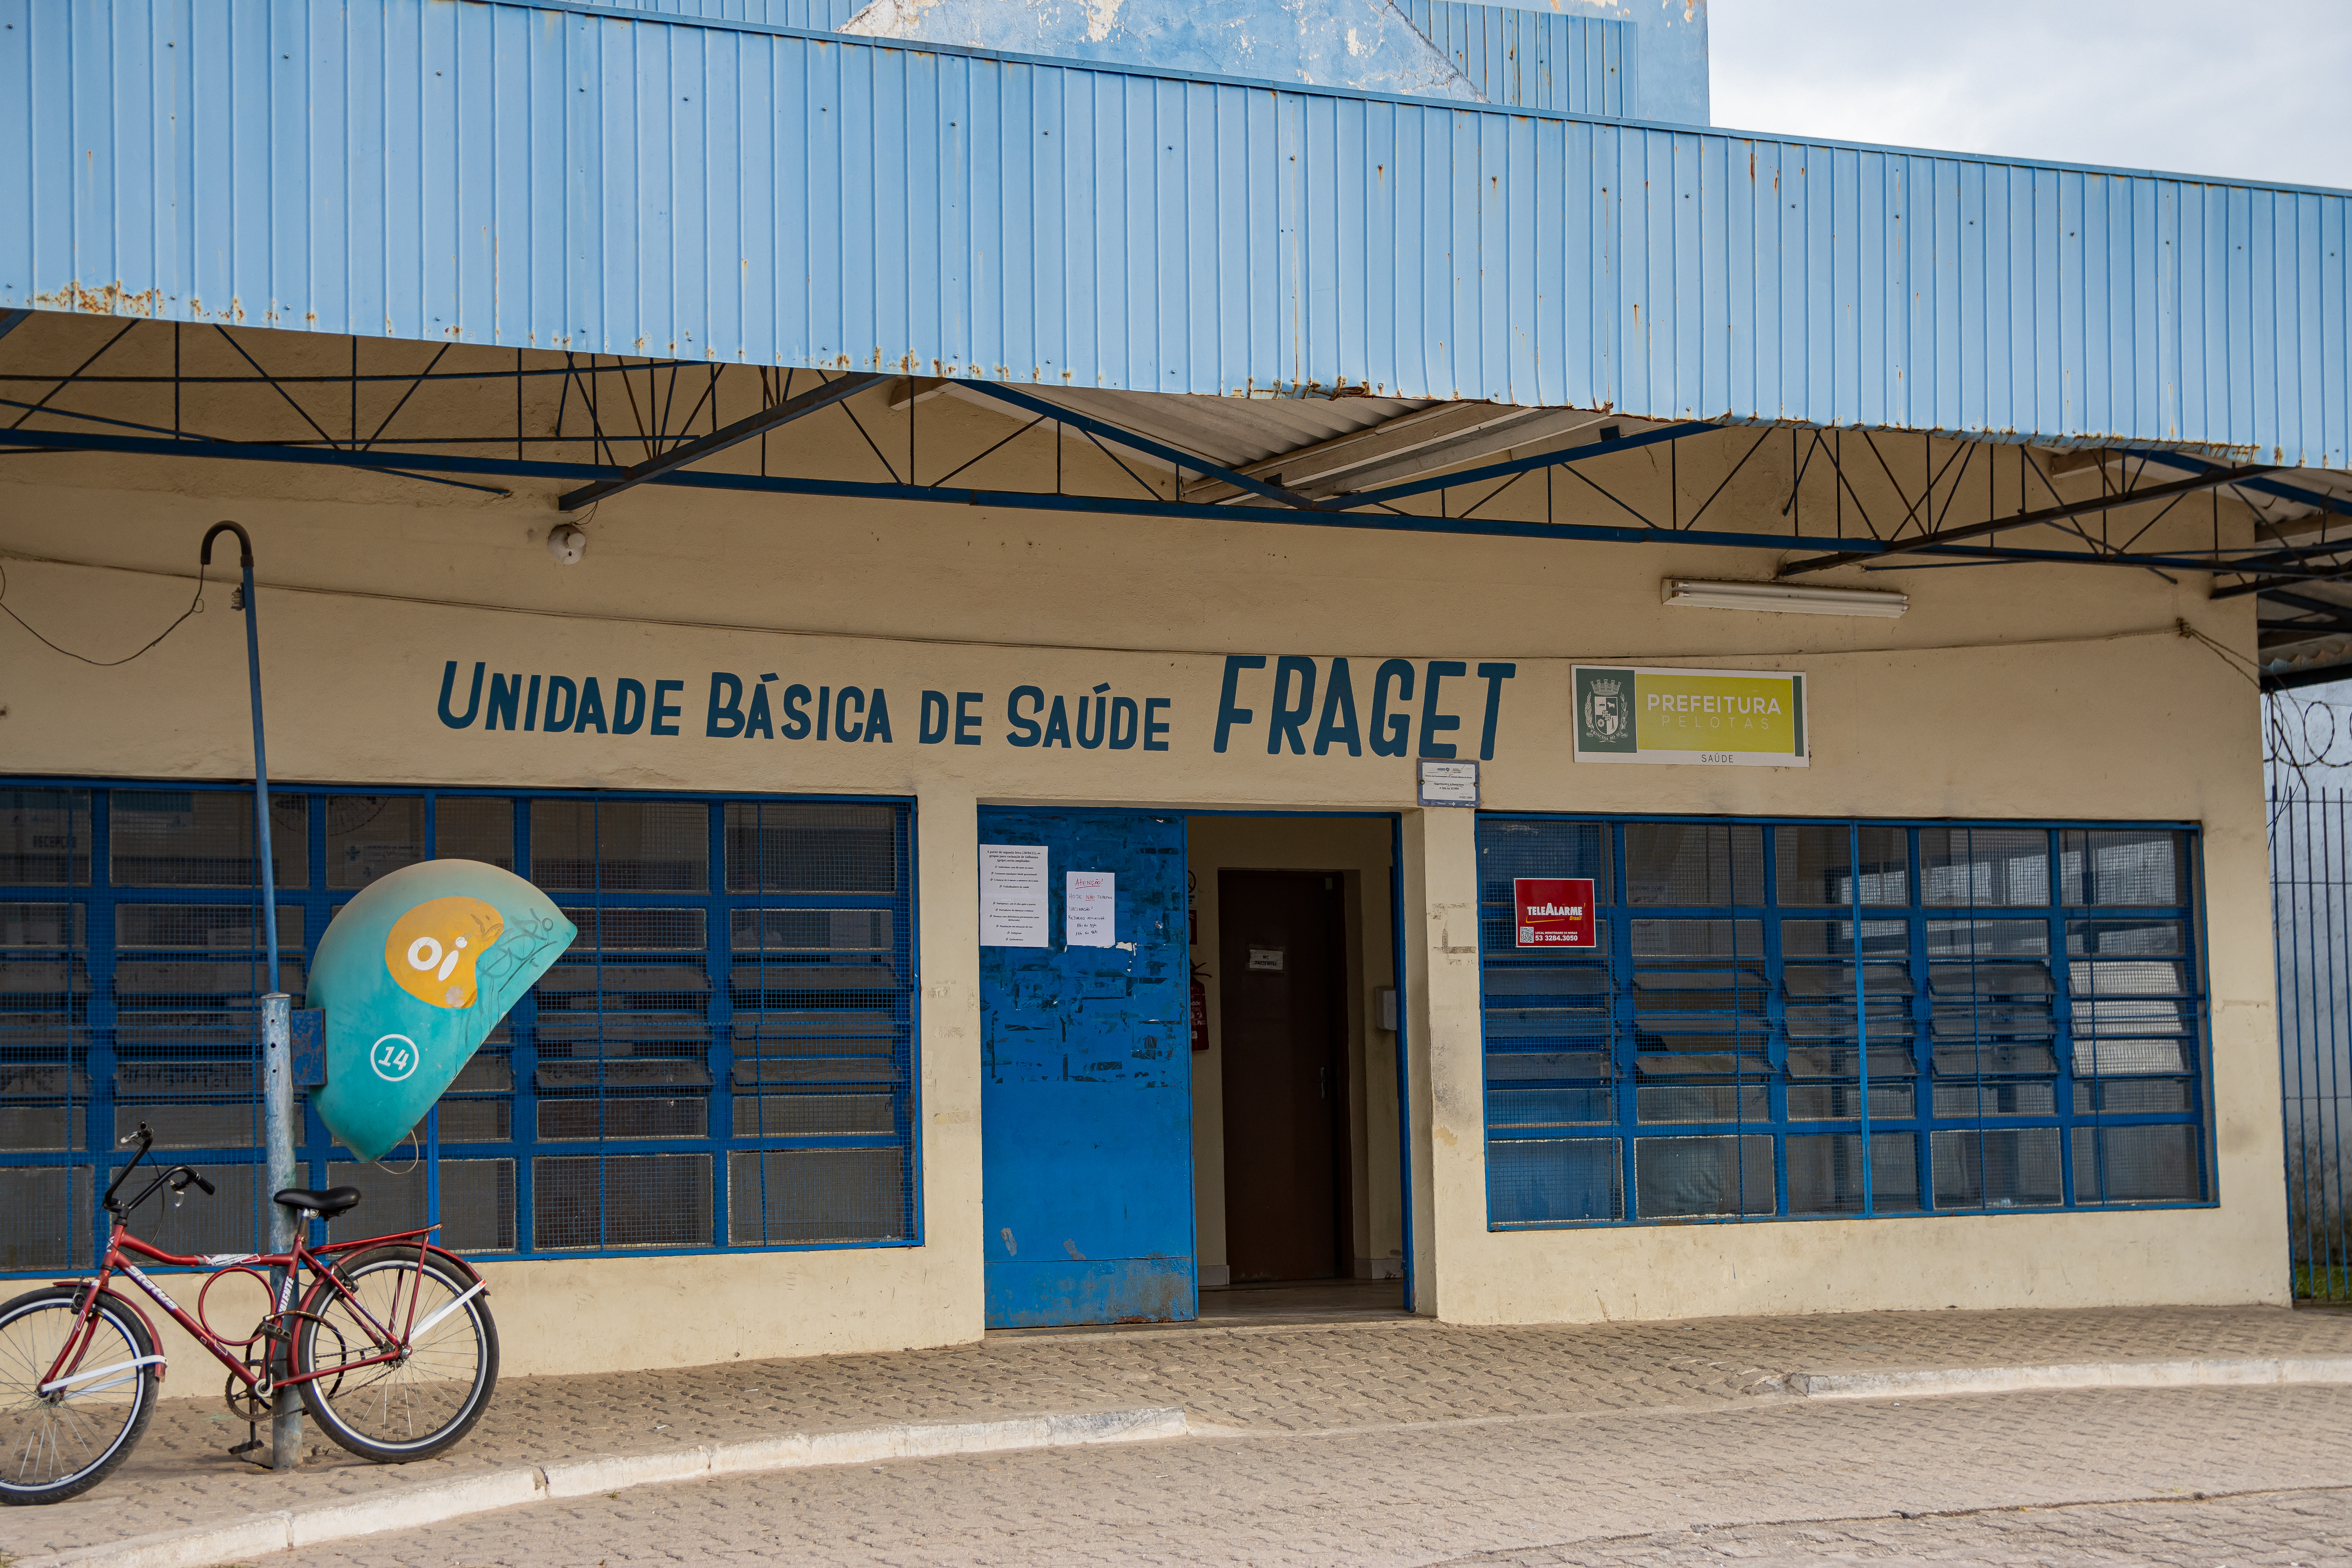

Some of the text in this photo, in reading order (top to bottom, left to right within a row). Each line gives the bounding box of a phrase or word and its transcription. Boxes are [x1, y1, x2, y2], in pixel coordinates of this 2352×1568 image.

[438, 656, 1515, 760] UNIDADE BÁSICA DE SAÚDE FRAGET
[1647, 694, 1782, 715] PREFEITURA
[1662, 716, 1769, 729] PELOTAS
[1590, 729, 1608, 740] PRINCESA
[1701, 753, 1734, 763] SAÚDE
[378, 1046, 409, 1070] 14
[124, 1265, 179, 1310] Status
